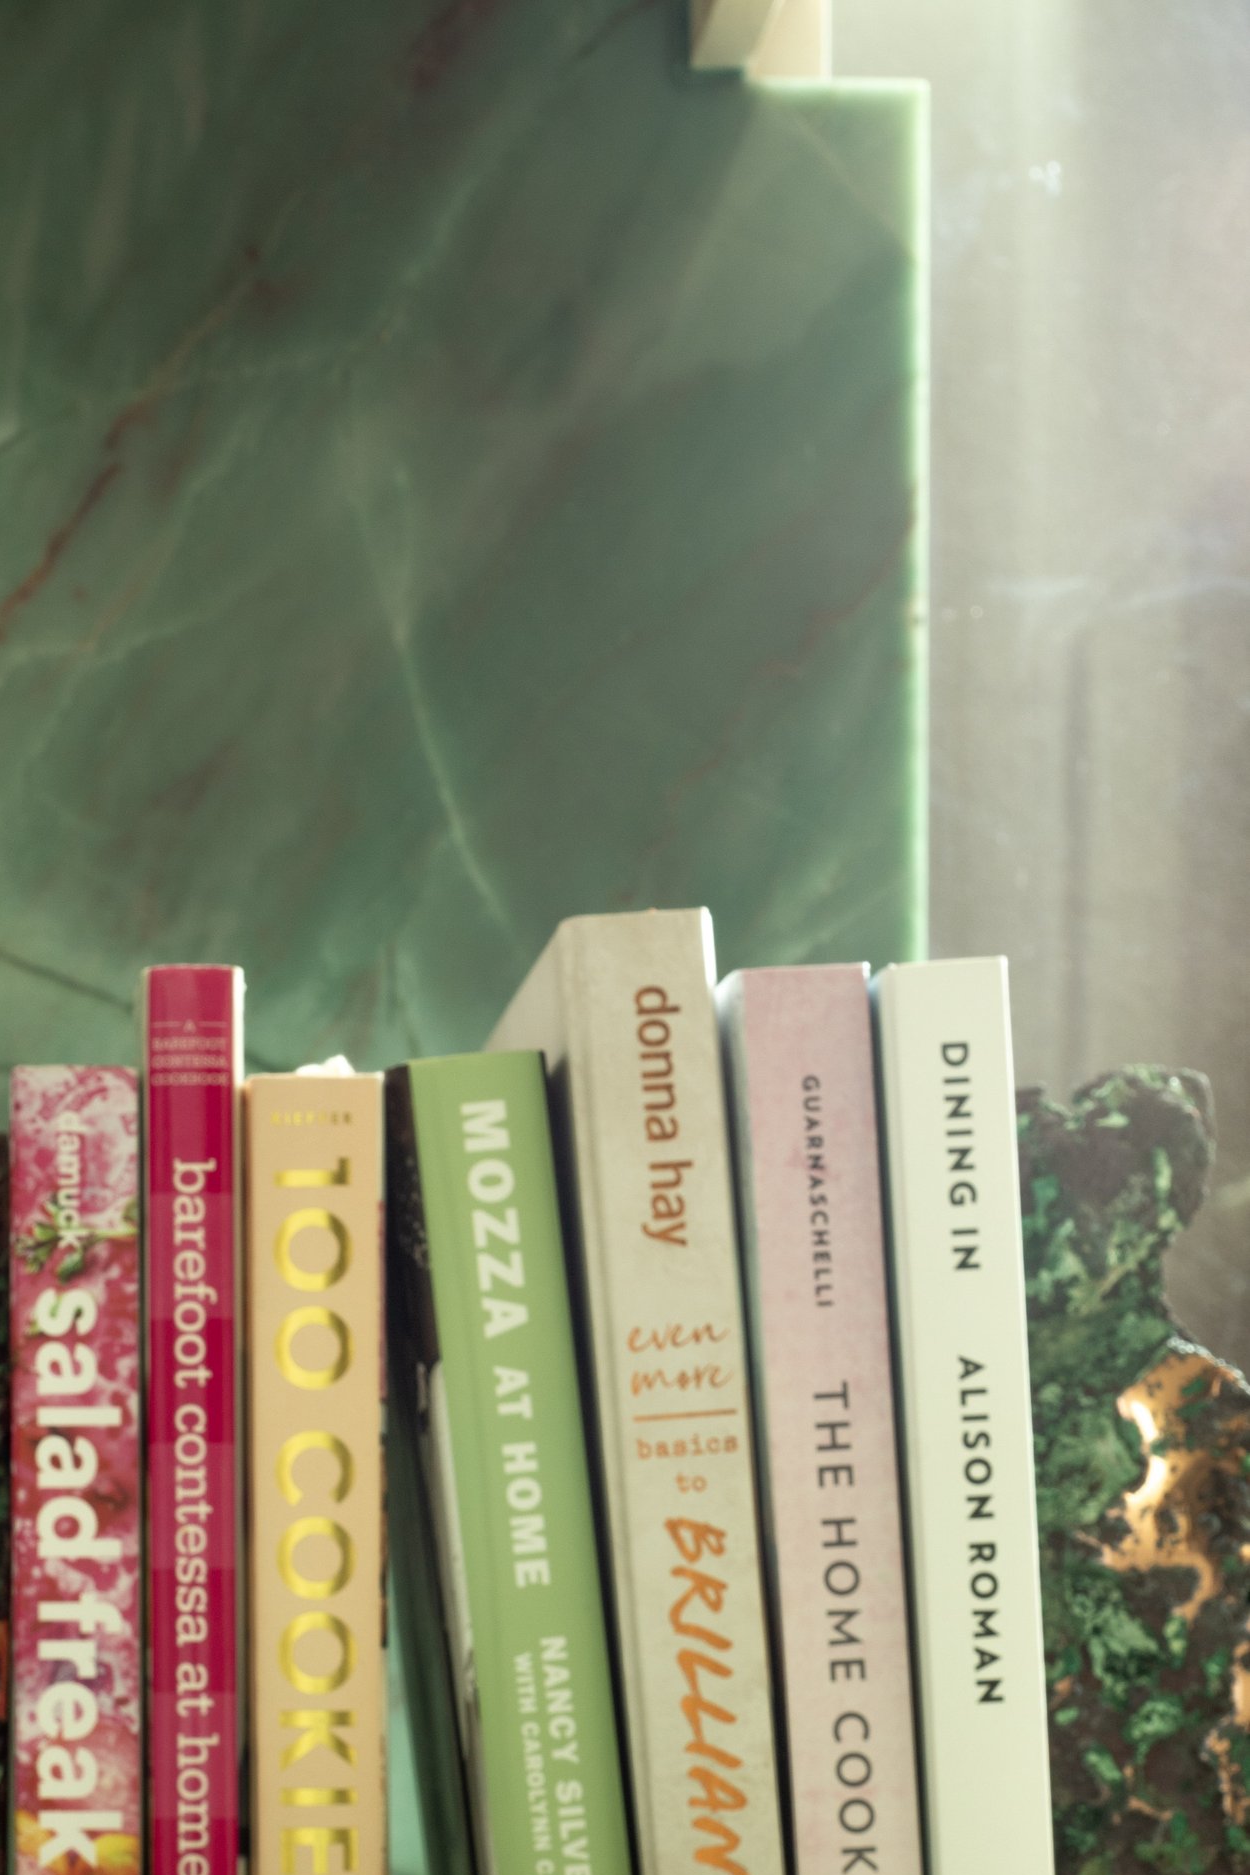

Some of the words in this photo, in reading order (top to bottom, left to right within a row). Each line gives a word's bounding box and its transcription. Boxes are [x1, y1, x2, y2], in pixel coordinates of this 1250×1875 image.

[633, 984, 681, 1143] donna
[940, 1041, 978, 1208] DINING
[460, 1098, 529, 1339] MOZZA
[643, 1160, 693, 1248] hay
[801, 1074, 834, 1308] GUARNASCHELLI
[950, 1228, 980, 1272] IN
[173, 1158, 217, 1389] barefoot
[627, 1322, 731, 1354] even
[35, 1287, 122, 1561] salad
[492, 1366, 534, 1421] AT
[630, 1364, 735, 1397] more
[636, 1433, 739, 1460] basics
[813, 1381, 855, 1489] THE
[957, 1356, 996, 1521] ALISON
[174, 1403, 213, 1646] contessa
[501, 1441, 551, 1588] HOME
[676, 1472, 708, 1493] to
[821, 1517, 867, 1684] HOME
[968, 1541, 1004, 1706] ROMAN
[37, 1593, 123, 1868] freak
[176, 1662, 213, 1717] at
[513, 1652, 537, 1714] WITH
[540, 1635, 579, 1765] NANCY
[832, 1711, 879, 1875] COOK
